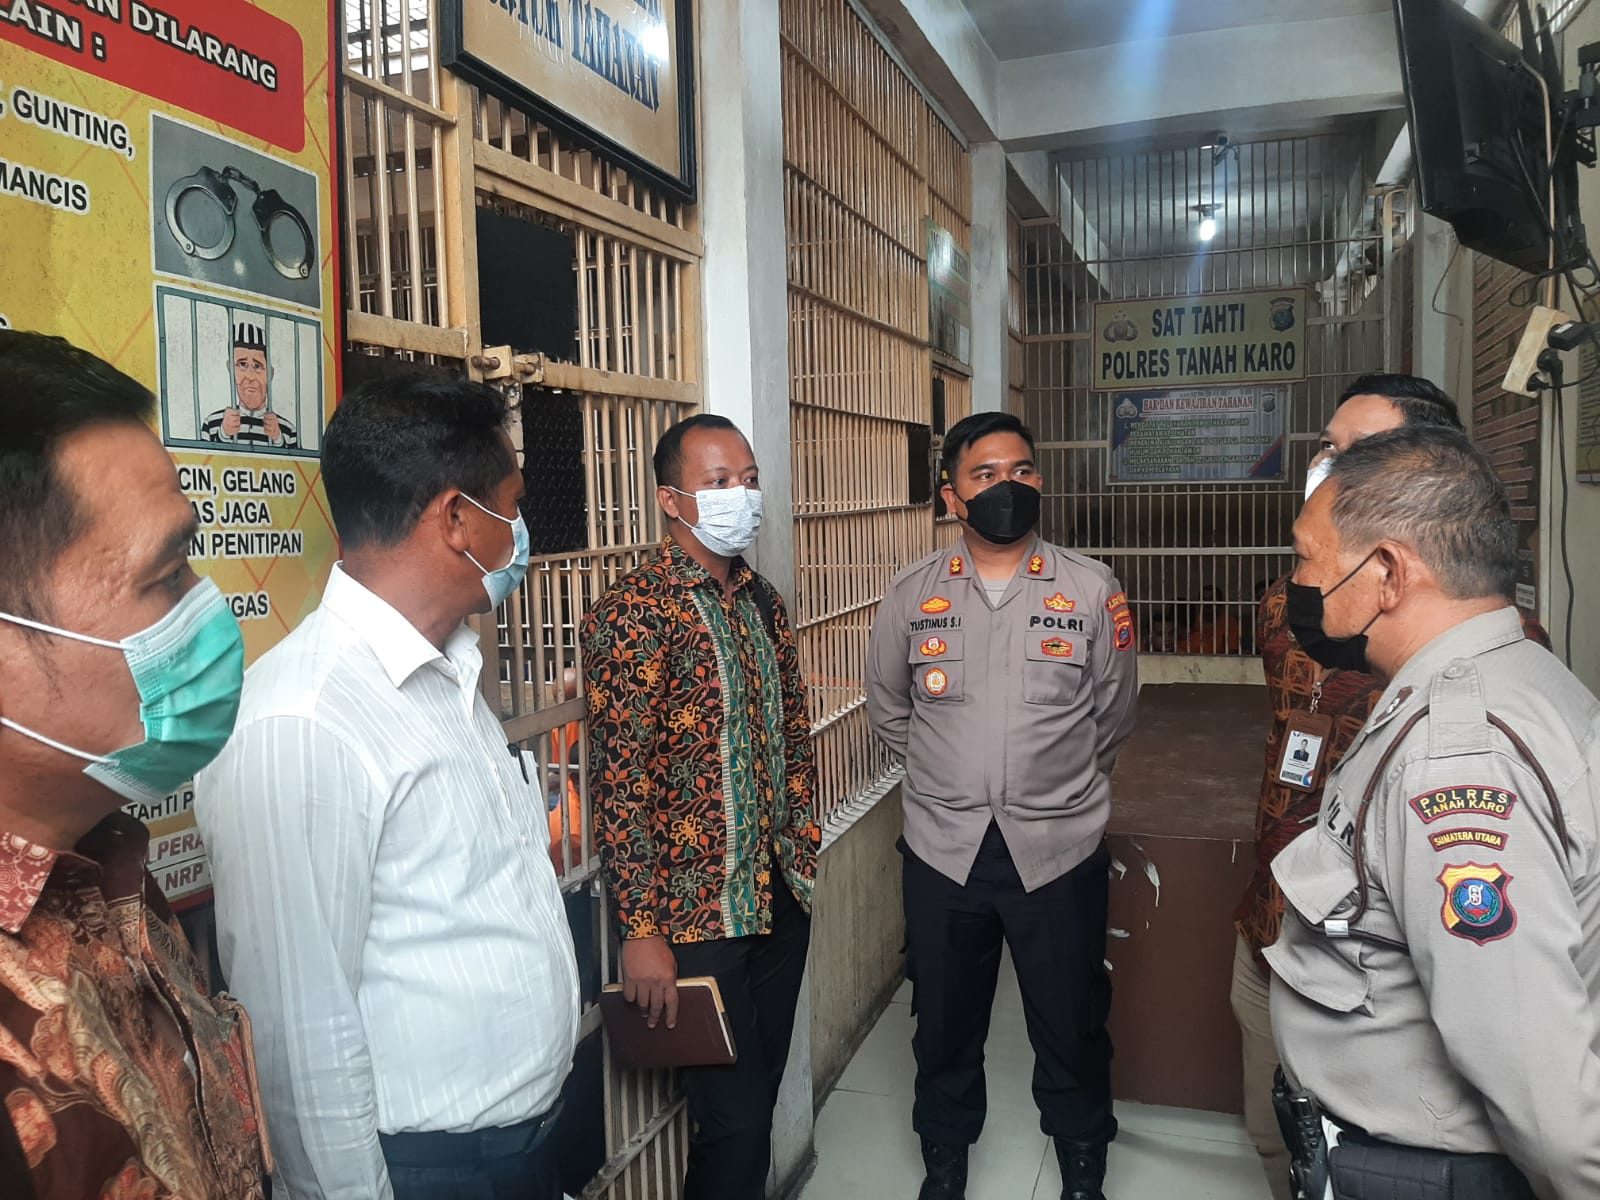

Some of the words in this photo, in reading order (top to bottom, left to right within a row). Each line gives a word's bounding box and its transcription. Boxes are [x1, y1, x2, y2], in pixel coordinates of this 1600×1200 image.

[0, 0, 80, 49] AIN
[132, 3, 276, 88] DILARANG
[13, 89, 133, 157] GUNTING,
[1152, 307, 1185, 338] SAT
[1192, 303, 1245, 335] TAHTI
[1103, 348, 1170, 380] POLRES
[1176, 345, 1237, 376] TANAH
[1244, 341, 1296, 373] KARO
[223, 469, 295, 494] GELANG
[221, 501, 271, 524] JAGA
[212, 532, 302, 556] PENITIPAN
[910, 617, 948, 632] YUSTINUS
[1029, 615, 1084, 632] POLRI
[1420, 788, 1508, 809] POLRES
[1424, 799, 1465, 818] TANAH
[1469, 799, 1505, 813] KARO
[1433, 831, 1474, 846] SUMATERA
[1475, 832, 1502, 846] UTARA
[165, 863, 204, 891] NRP
